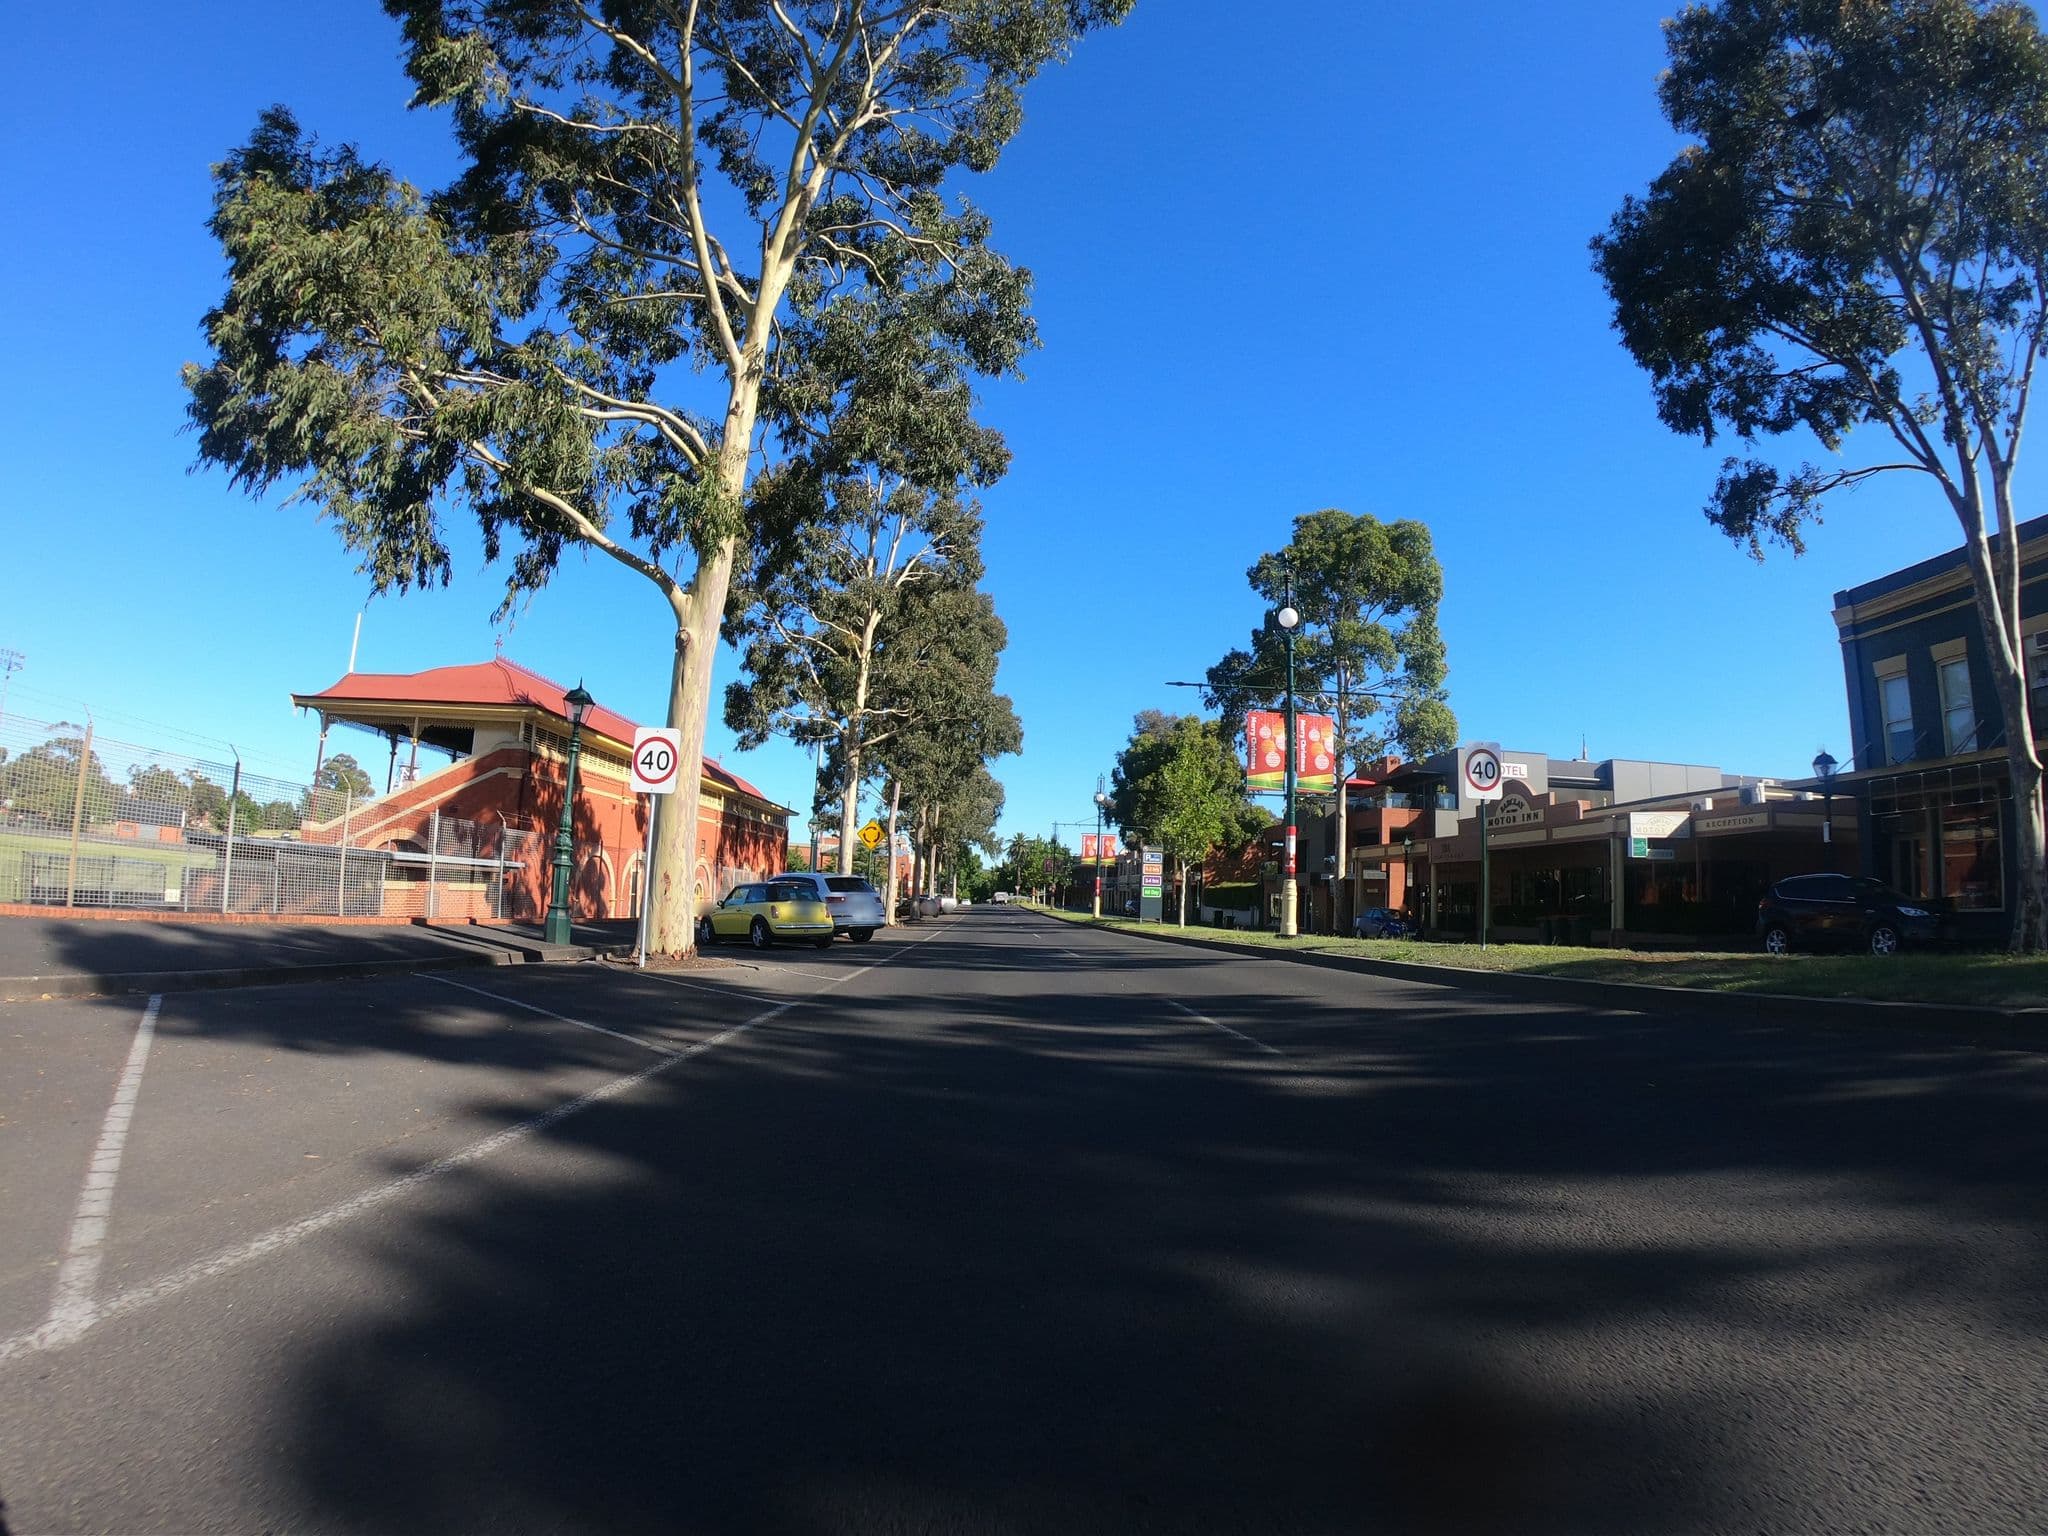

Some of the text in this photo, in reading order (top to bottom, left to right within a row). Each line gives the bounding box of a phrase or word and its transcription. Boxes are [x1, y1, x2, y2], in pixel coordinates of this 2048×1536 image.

[640, 750, 670, 771] 40
[1471, 761, 1496, 780] 40
[1501, 765, 1525, 776] OTEL
[1488, 811, 1539, 827] MOTOR INN
[1706, 817, 1754, 828] RECEPTION
